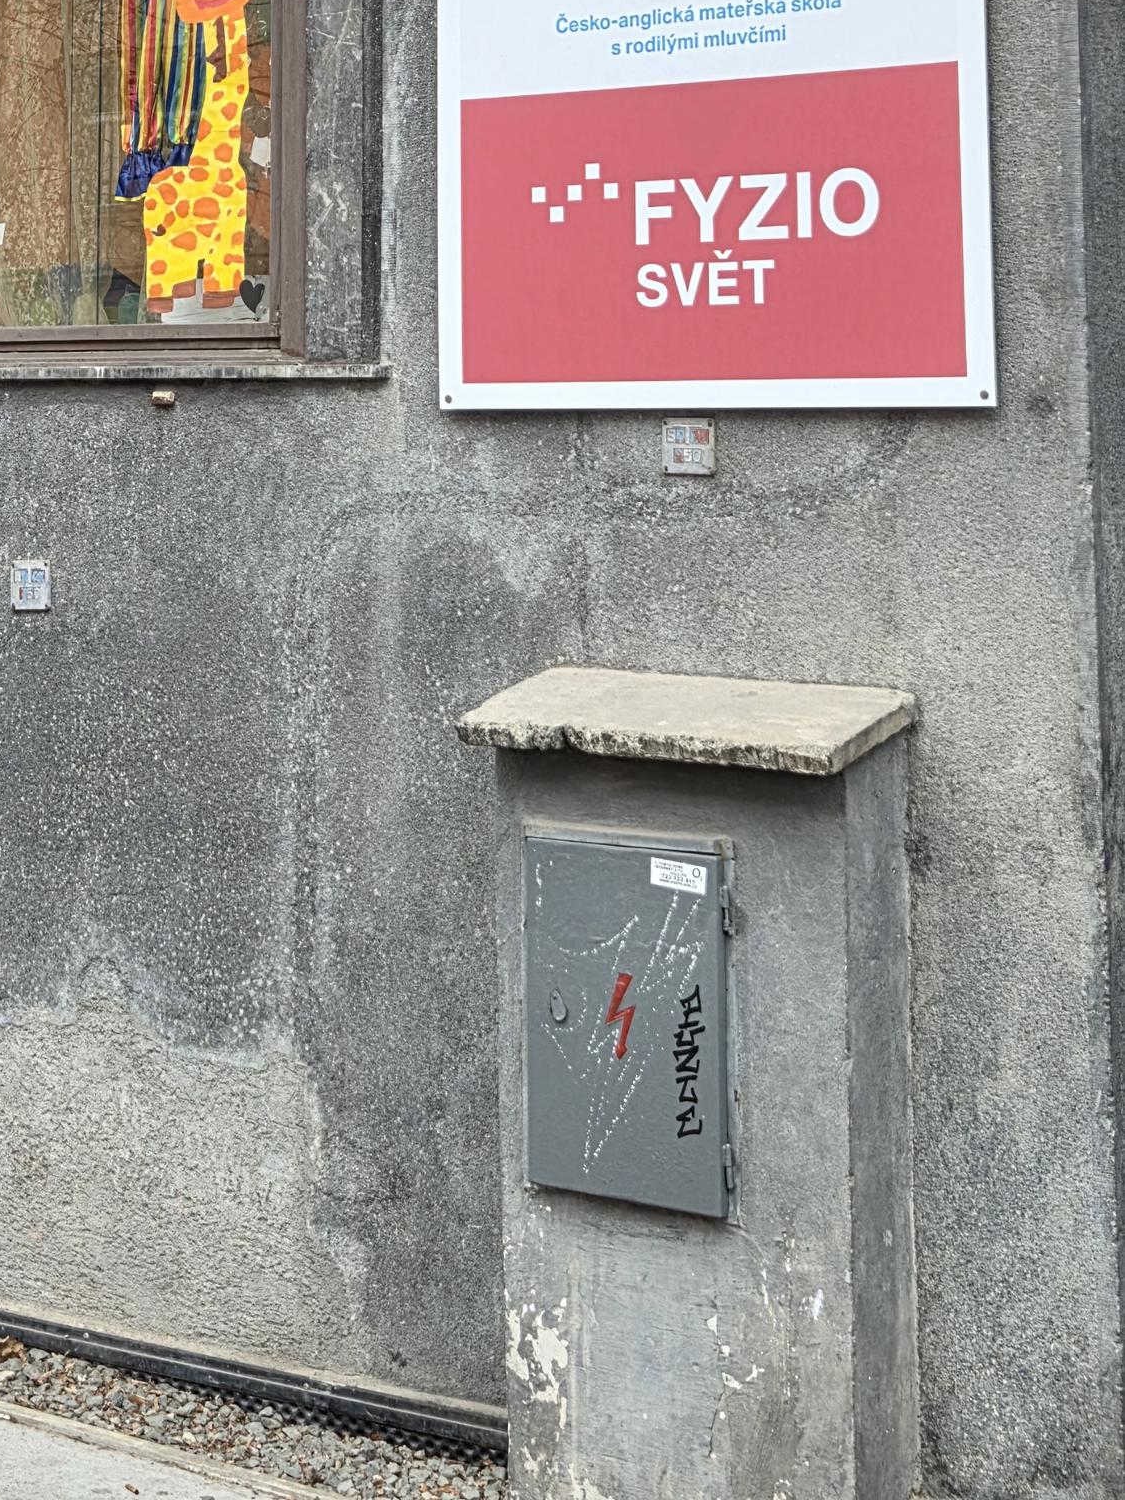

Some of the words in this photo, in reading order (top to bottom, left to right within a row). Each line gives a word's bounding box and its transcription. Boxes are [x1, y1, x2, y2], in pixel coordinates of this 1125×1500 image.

[555, 4, 695, 34] Česko-anglická
[610, 42, 621, 56] s
[625, 31, 699, 55] rodilými
[703, 24, 787, 48] mluvčími
[634, 167, 880, 246] FYZIO
[636, 249, 775, 308] SVĚT
